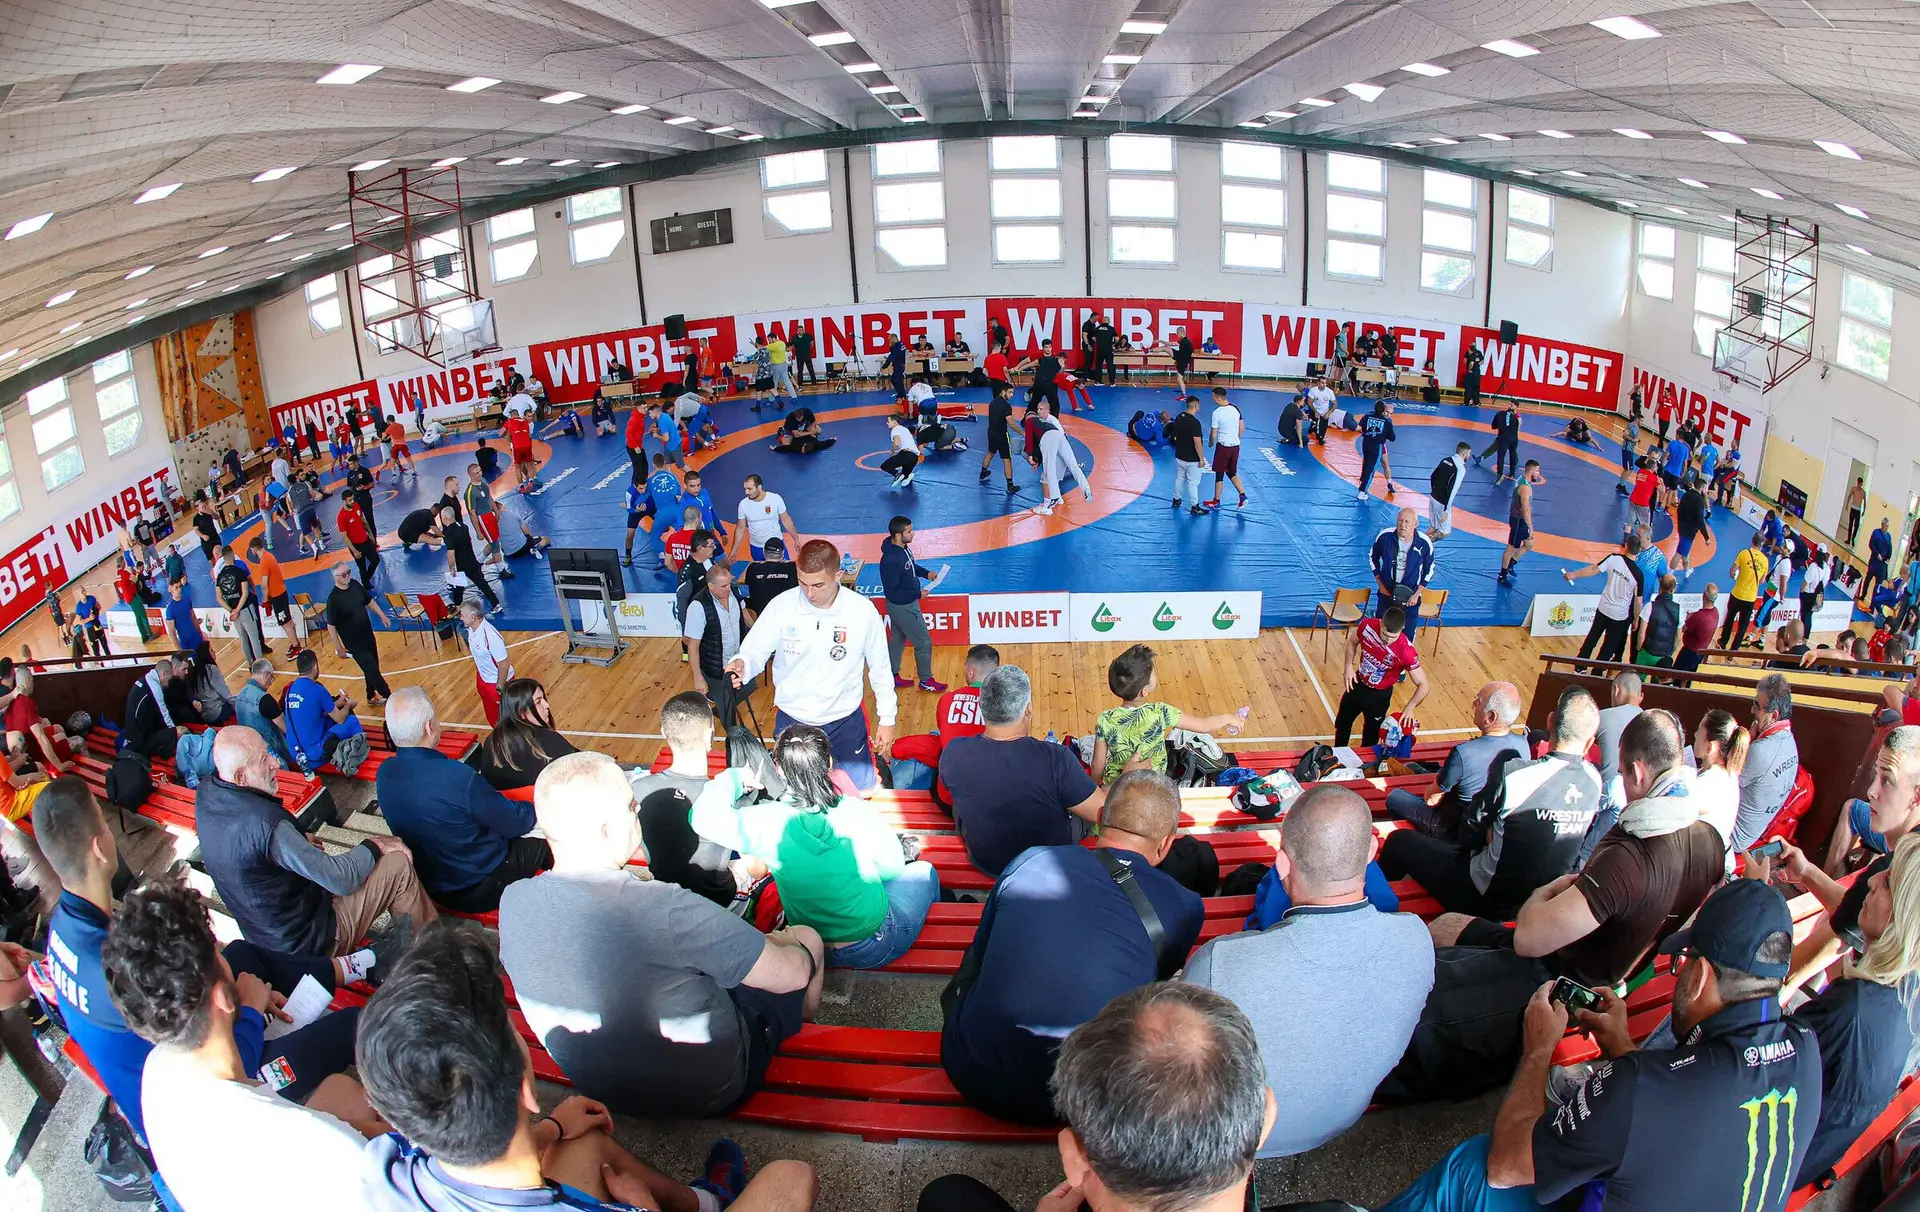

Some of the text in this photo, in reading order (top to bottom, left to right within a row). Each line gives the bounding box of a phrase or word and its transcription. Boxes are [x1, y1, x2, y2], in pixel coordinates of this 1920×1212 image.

[697, 220, 716, 229] GUESTS
[388, 357, 517, 415] WINBET
[543, 327, 718, 388] WINBET
[1476, 336, 1613, 393] WINBET
[66, 466, 170, 554] WINBET
[977, 609, 1062, 629] WINBET
[1552, 822, 1584, 835] TEAM
